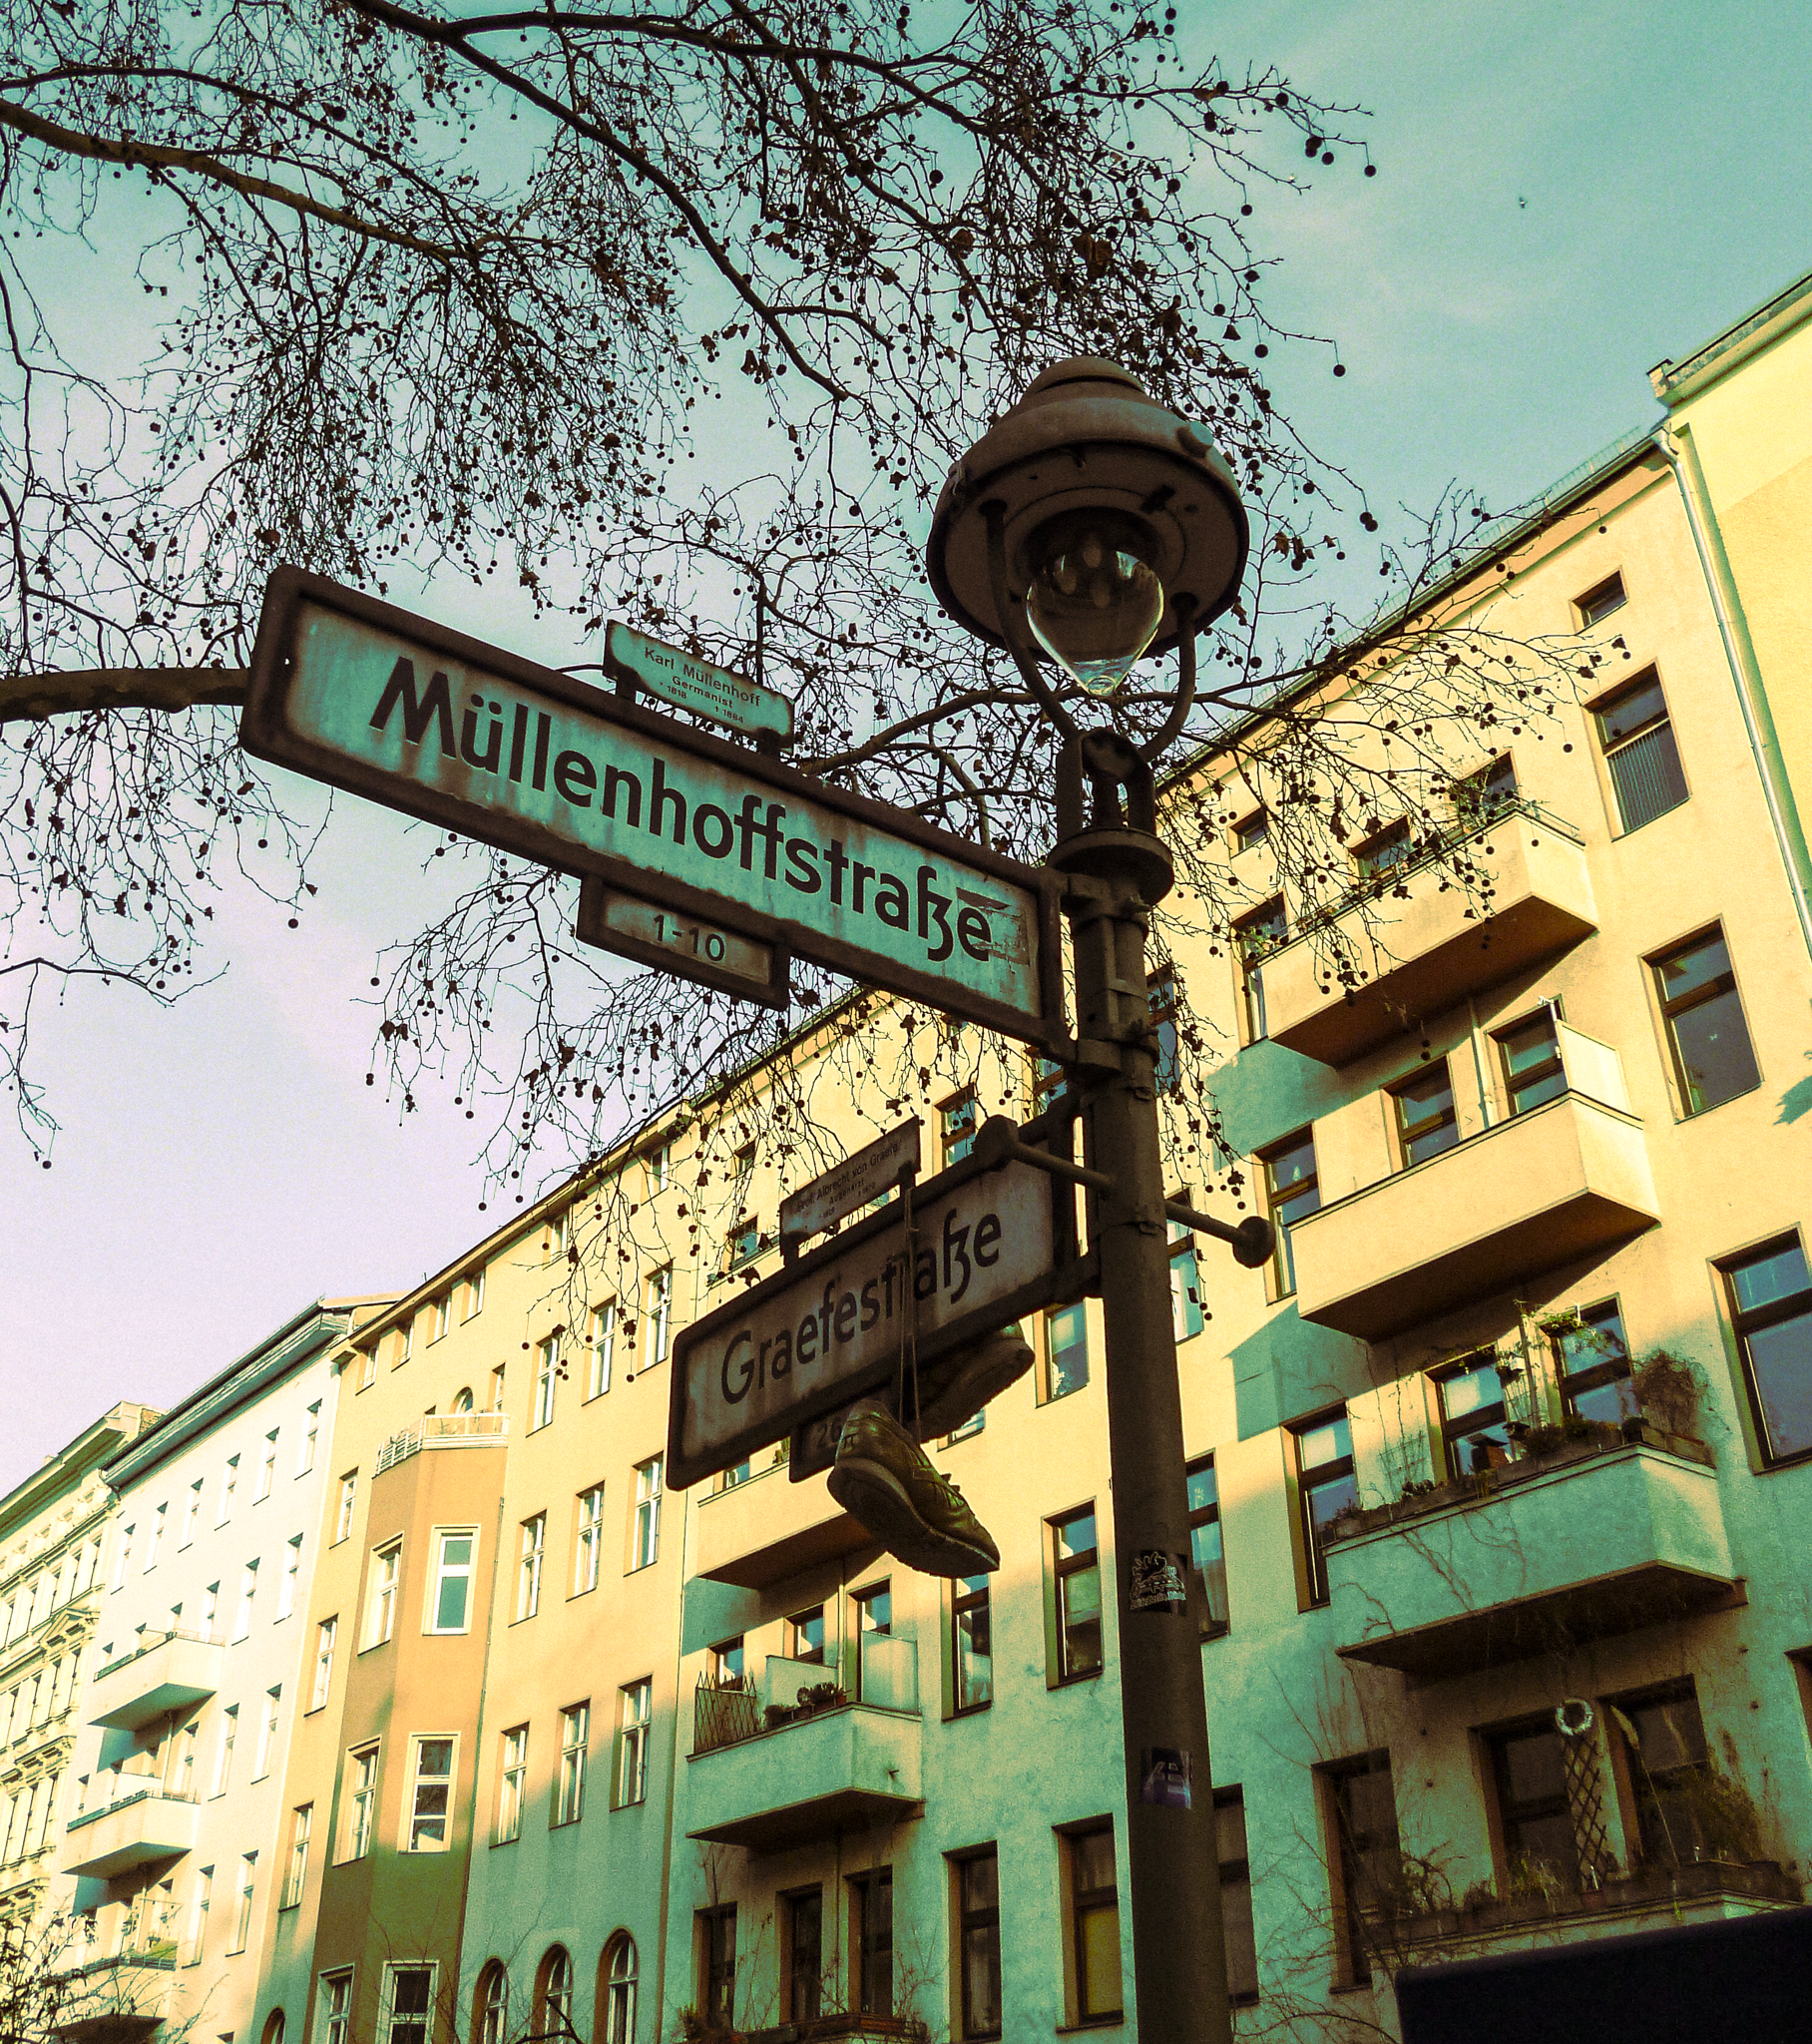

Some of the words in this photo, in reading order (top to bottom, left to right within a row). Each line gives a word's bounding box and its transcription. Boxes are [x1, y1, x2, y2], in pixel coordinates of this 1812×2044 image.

[645, 647, 675, 670] Karl
[682, 663, 761, 708] Müllenhoff
[672, 675, 733, 709] Germanist
[368, 656, 992, 962] Müllenhoffstraße
[653, 914, 725, 962] 1-10
[851, 1161, 867, 1177] von
